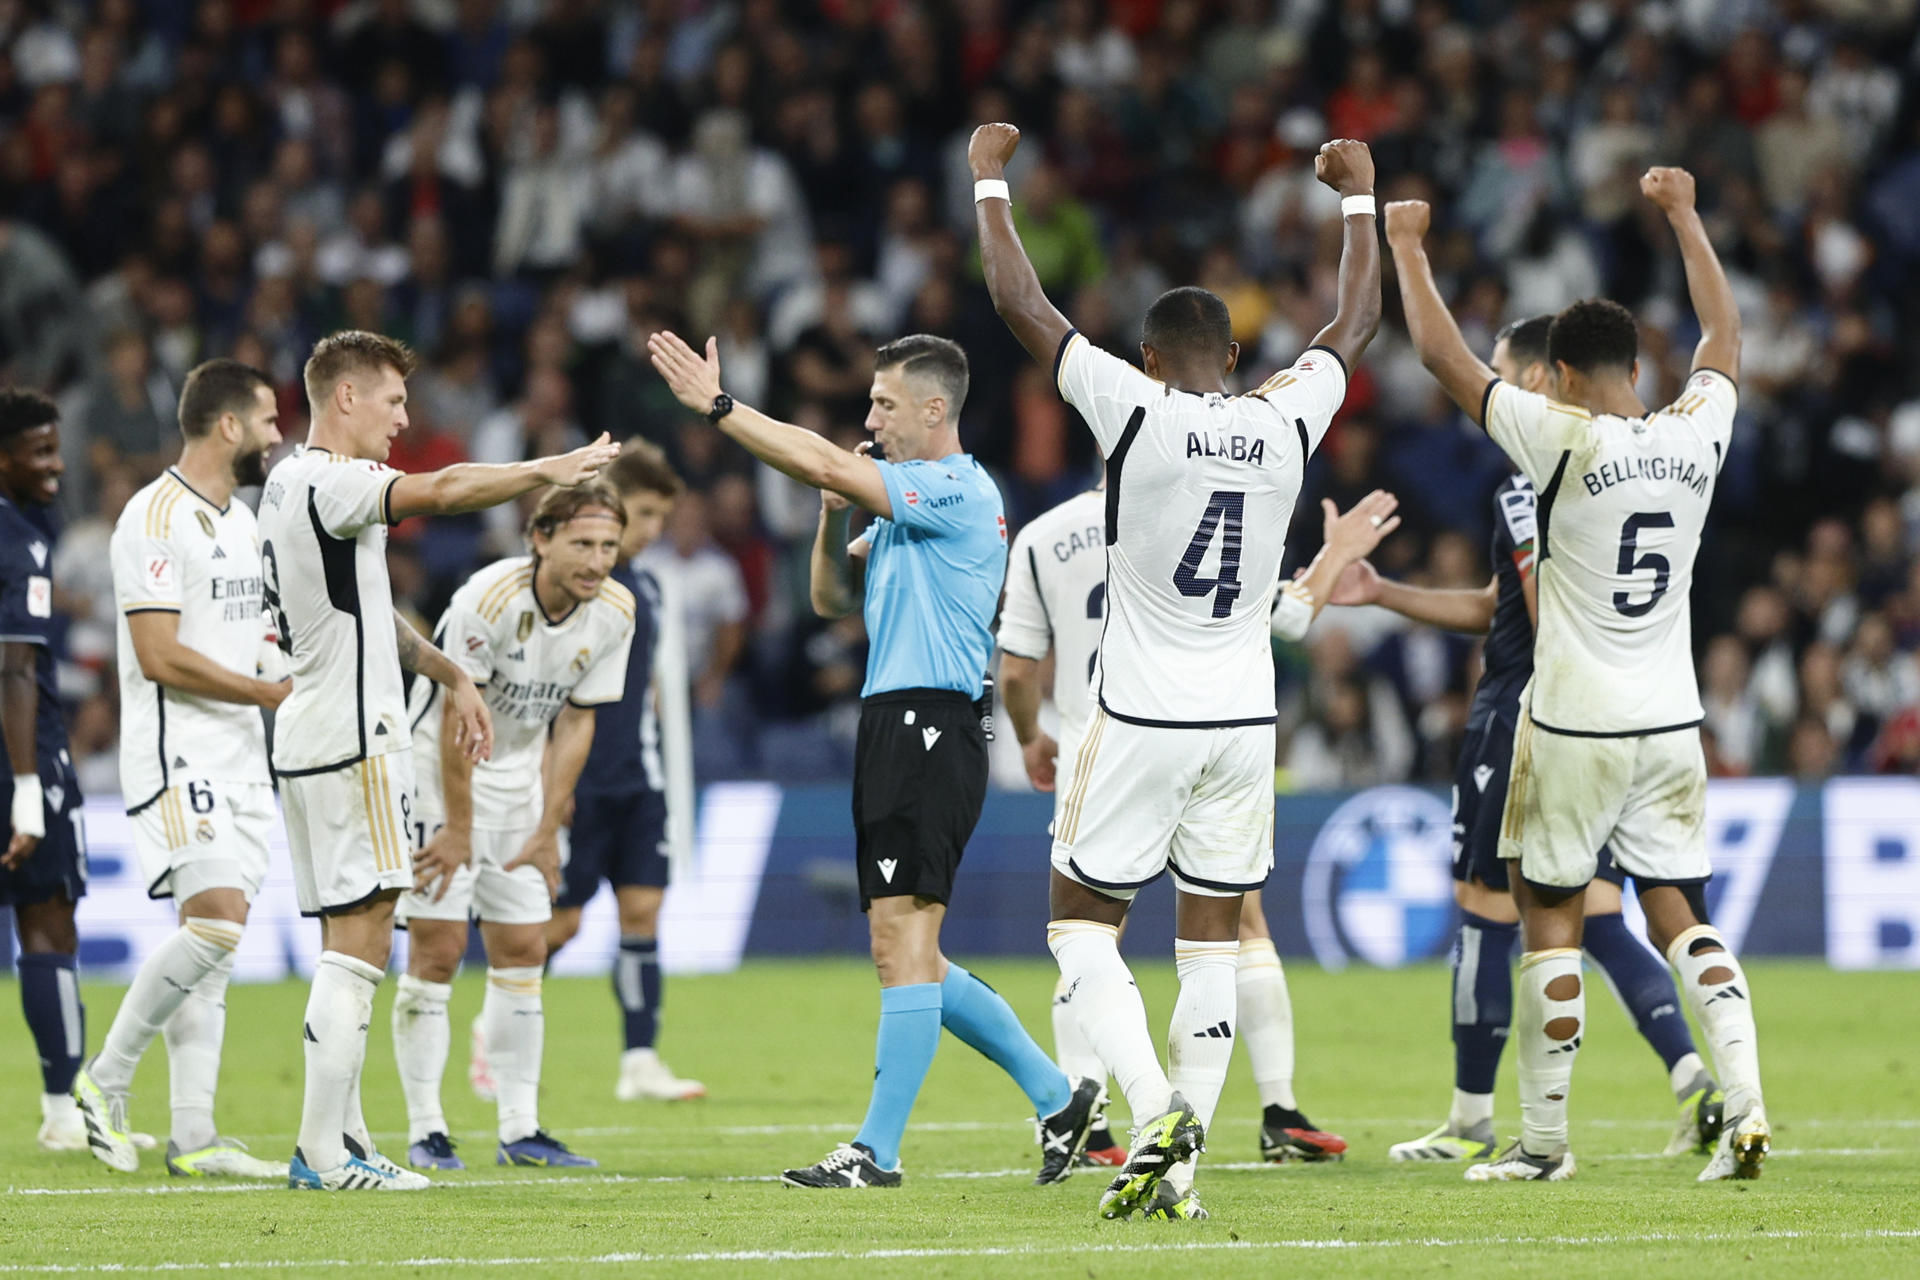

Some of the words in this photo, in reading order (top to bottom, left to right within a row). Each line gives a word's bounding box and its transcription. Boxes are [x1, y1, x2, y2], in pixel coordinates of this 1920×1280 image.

[1187, 432, 1265, 466] ALABA
[1172, 491, 1246, 619] 4
[1613, 511, 1675, 618] 5
[188, 779, 215, 814] 6
